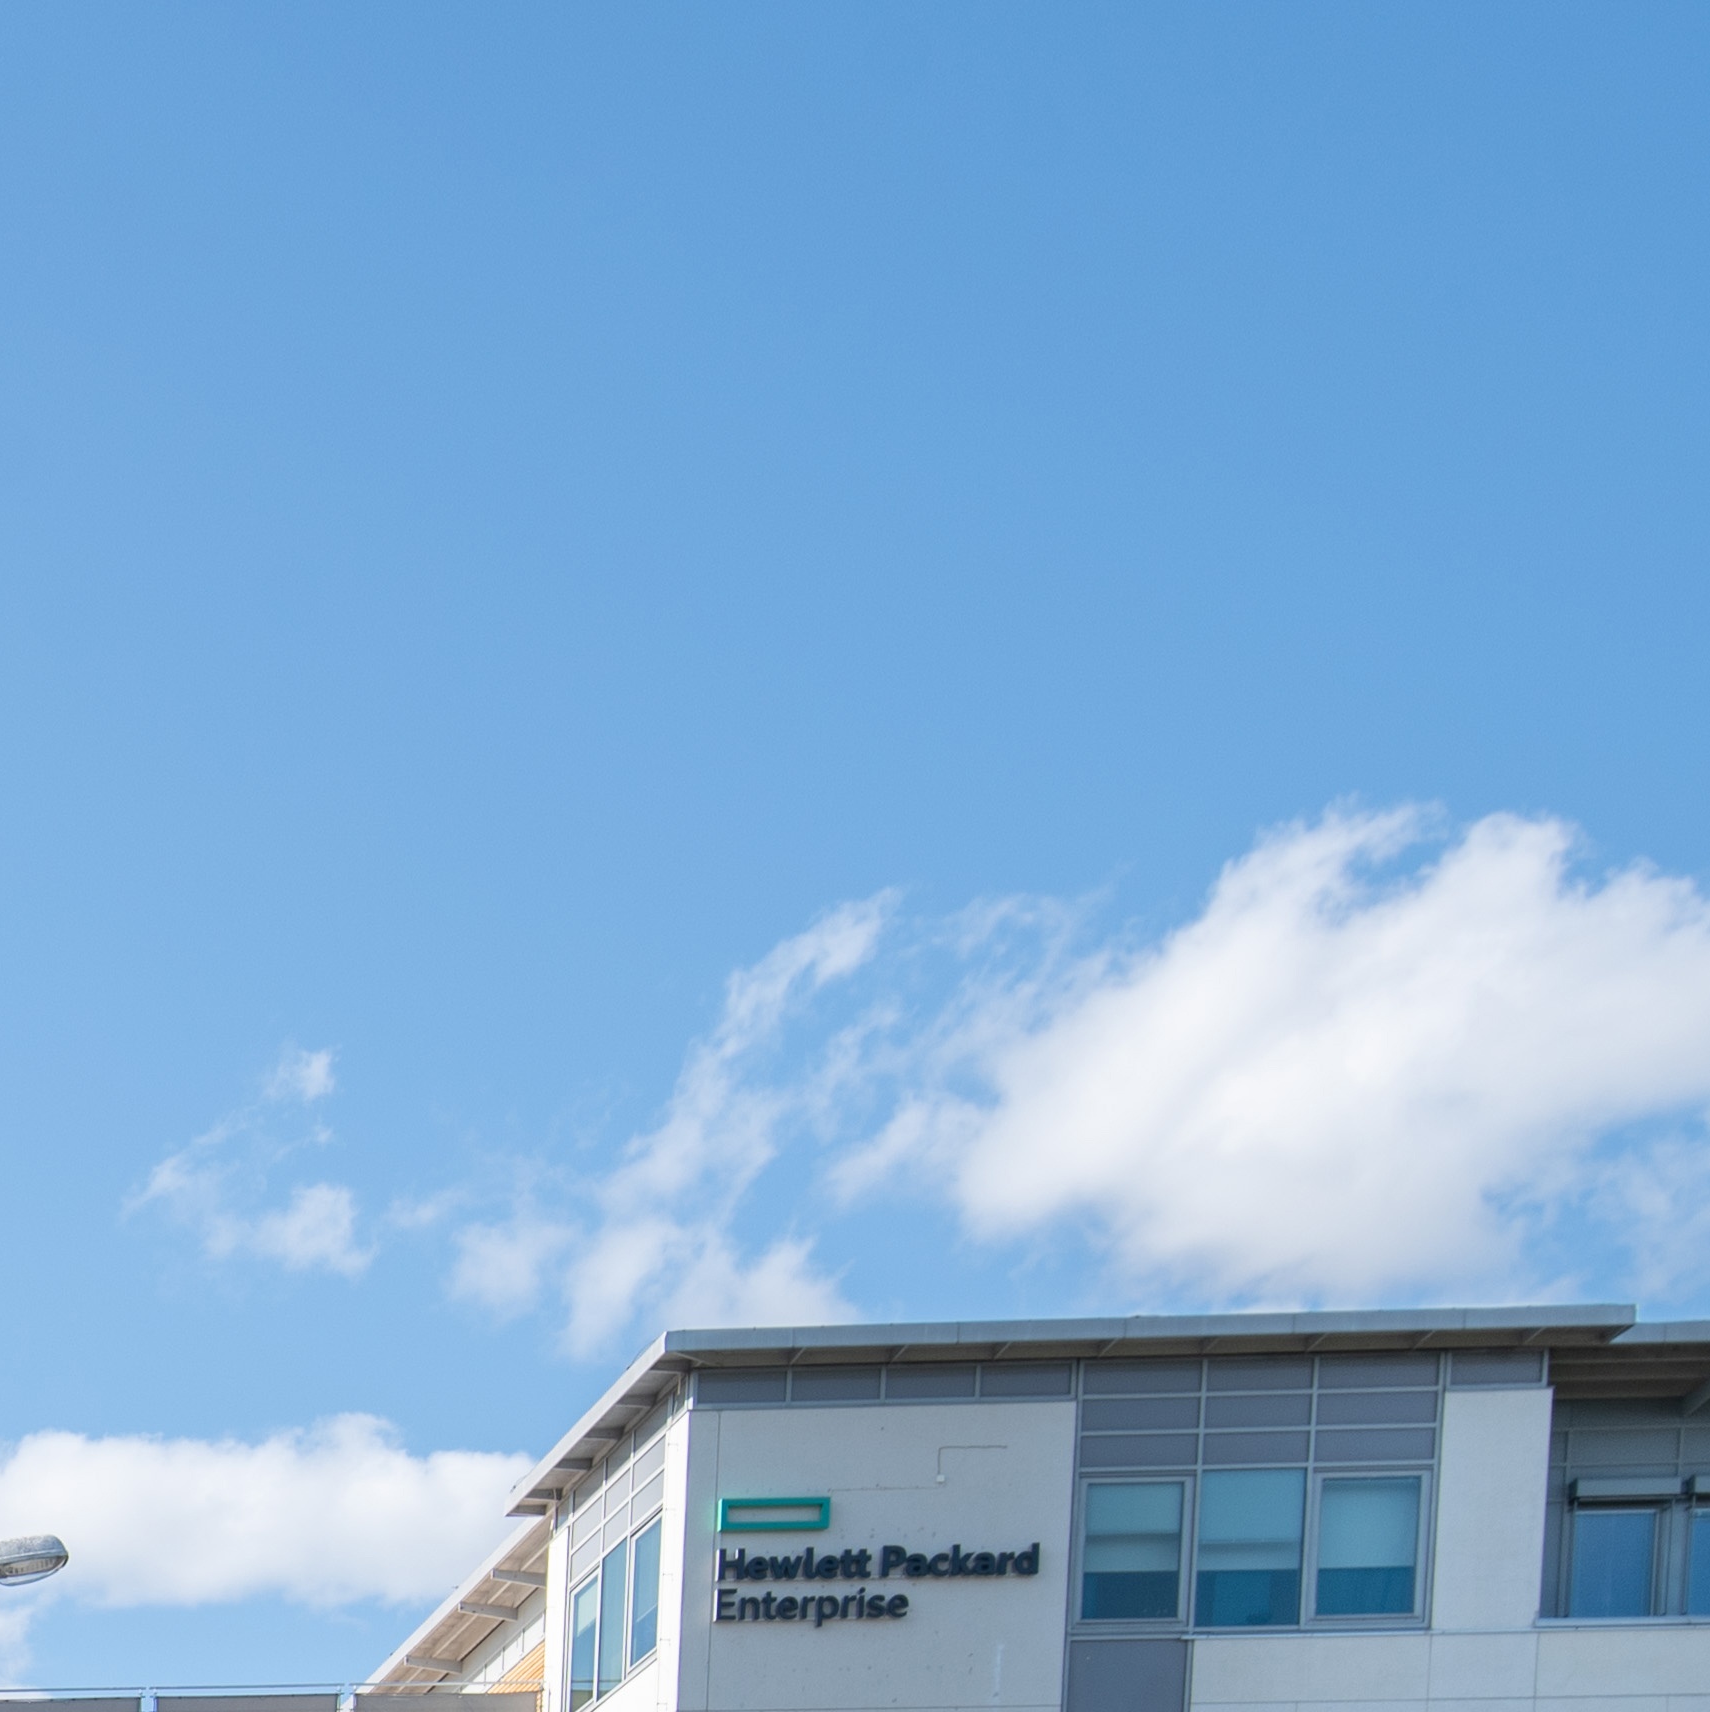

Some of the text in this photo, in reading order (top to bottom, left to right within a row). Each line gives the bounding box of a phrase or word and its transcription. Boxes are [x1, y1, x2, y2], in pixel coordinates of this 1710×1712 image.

[716, 1543, 1041, 1582] Hewlett Packard
[713, 1587, 909, 1627] Enterprise
